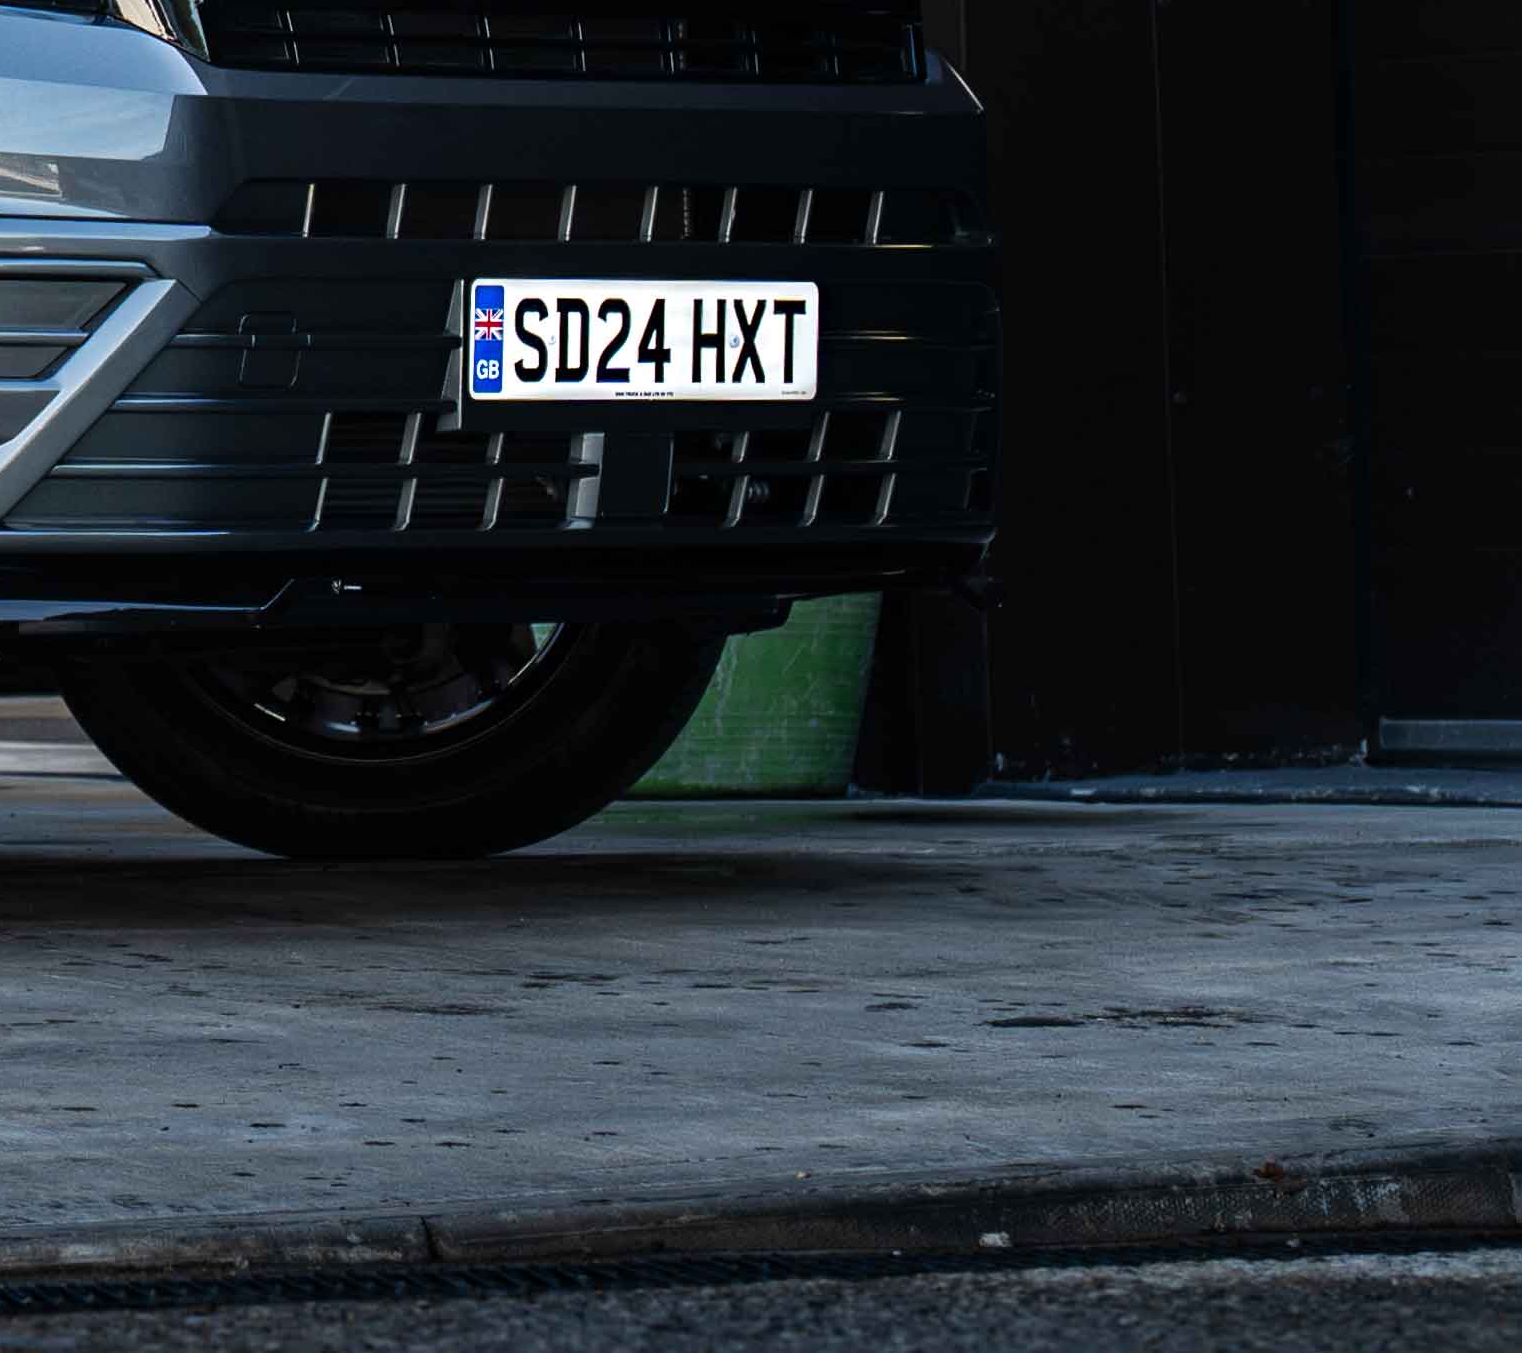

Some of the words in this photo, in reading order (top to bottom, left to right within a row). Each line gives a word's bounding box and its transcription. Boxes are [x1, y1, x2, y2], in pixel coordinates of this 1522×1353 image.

[476, 359, 501, 381] GB
[514, 297, 672, 383] SD24
[691, 298, 807, 384] HXT
